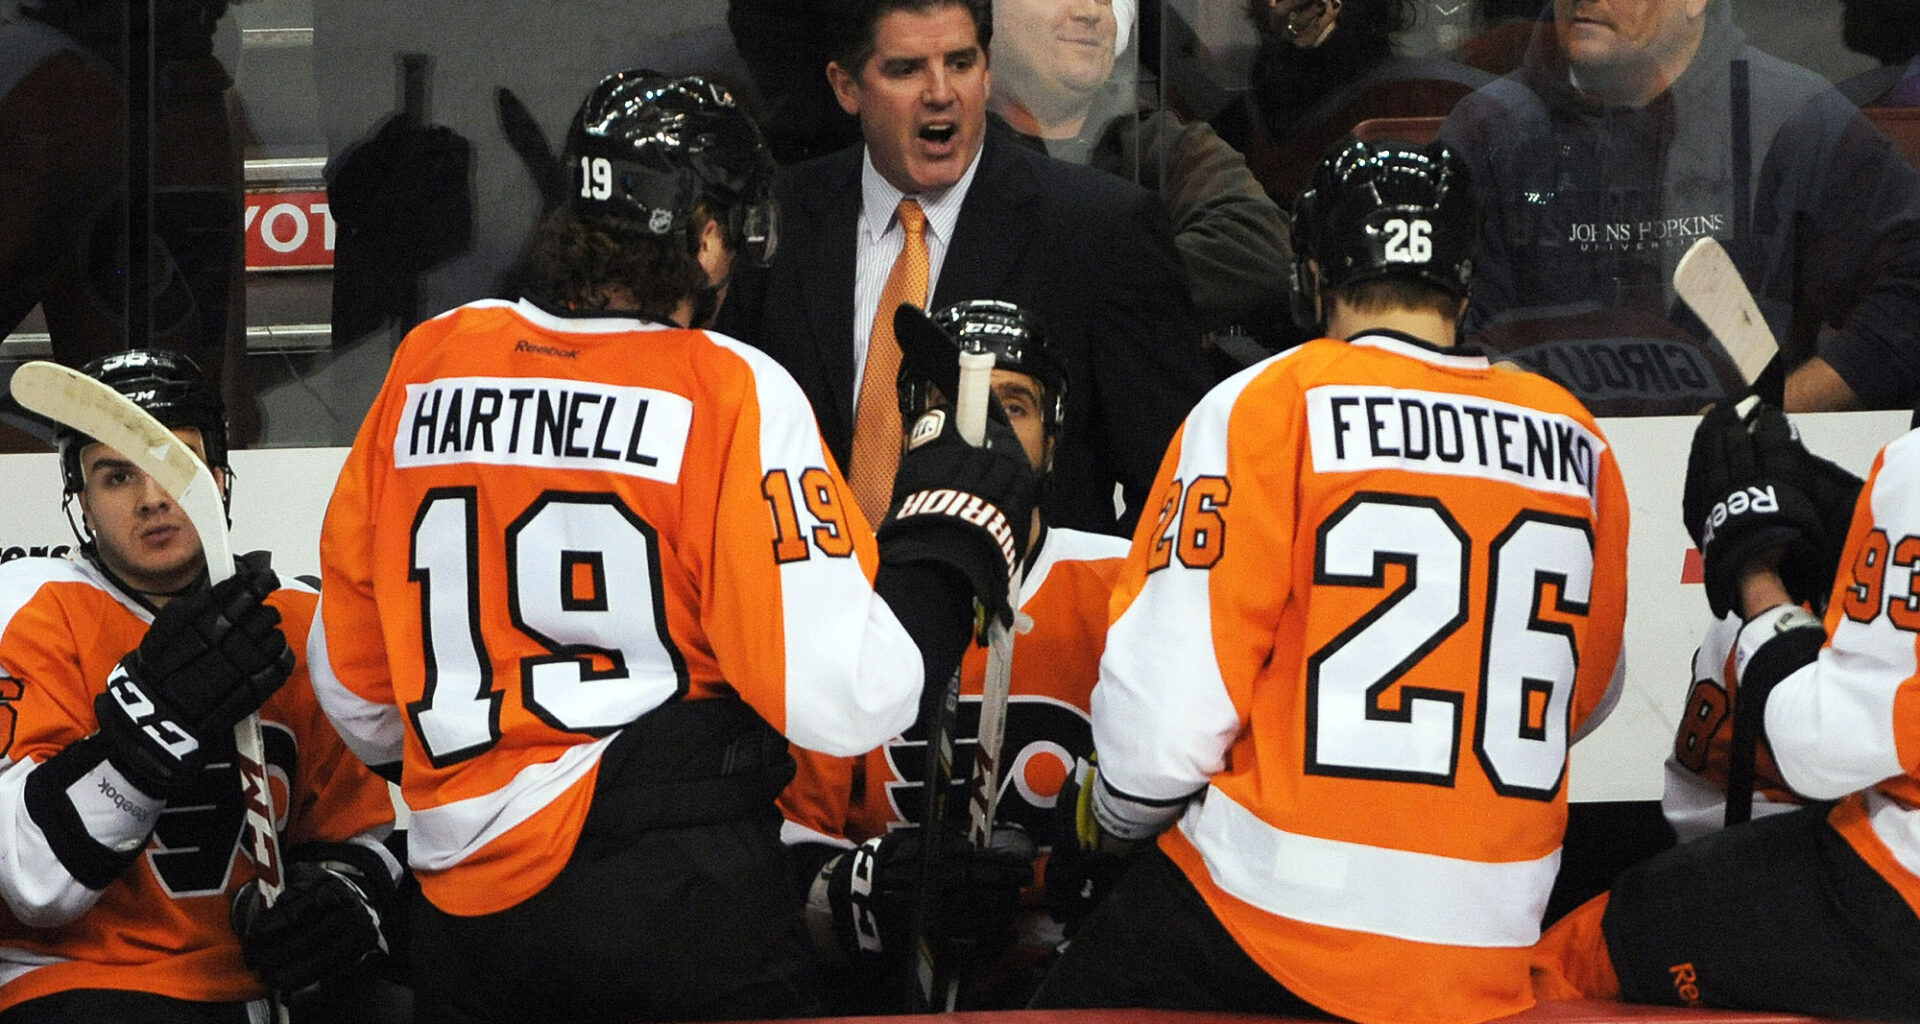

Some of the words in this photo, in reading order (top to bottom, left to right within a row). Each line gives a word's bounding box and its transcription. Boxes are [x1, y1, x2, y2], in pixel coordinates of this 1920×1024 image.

[581, 156, 612, 200] 19
[1384, 218, 1432, 263] 26
[1639, 214, 1725, 238] HOPKINS
[965, 322, 1022, 338] CCM
[409, 388, 658, 467] HARTNELL
[1331, 396, 1592, 497] FEDOTENKO
[761, 466, 855, 565] 19
[1146, 474, 1232, 575] 26
[406, 485, 690, 769] 19
[1304, 490, 1596, 802] 26
